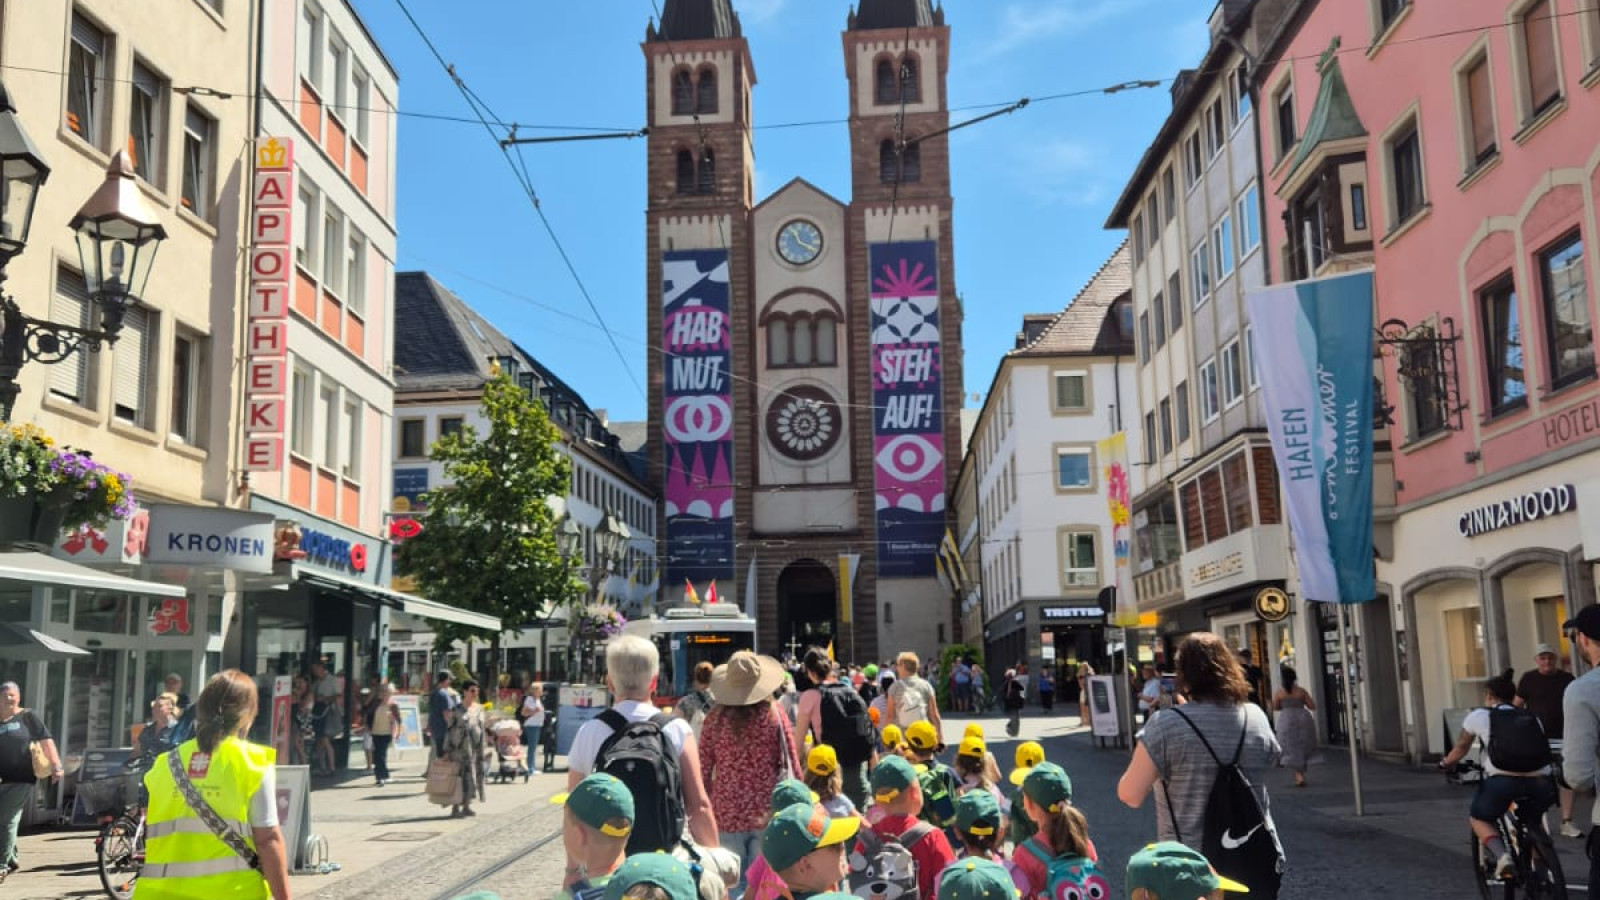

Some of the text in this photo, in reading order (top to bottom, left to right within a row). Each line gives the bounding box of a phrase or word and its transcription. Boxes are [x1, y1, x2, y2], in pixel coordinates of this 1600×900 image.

[247, 176, 284, 466] APOTHEKE
[672, 311, 724, 345] HAB
[672, 356, 724, 391] MUT,
[880, 348, 933, 384] STEH
[881, 394, 935, 429] AUF!
[1281, 407, 1315, 481] HAFEN
[1345, 399, 1360, 475] FESTIVAL
[1459, 484, 1570, 537] CINNAMOOD
[167, 532, 265, 557] KRONEN
